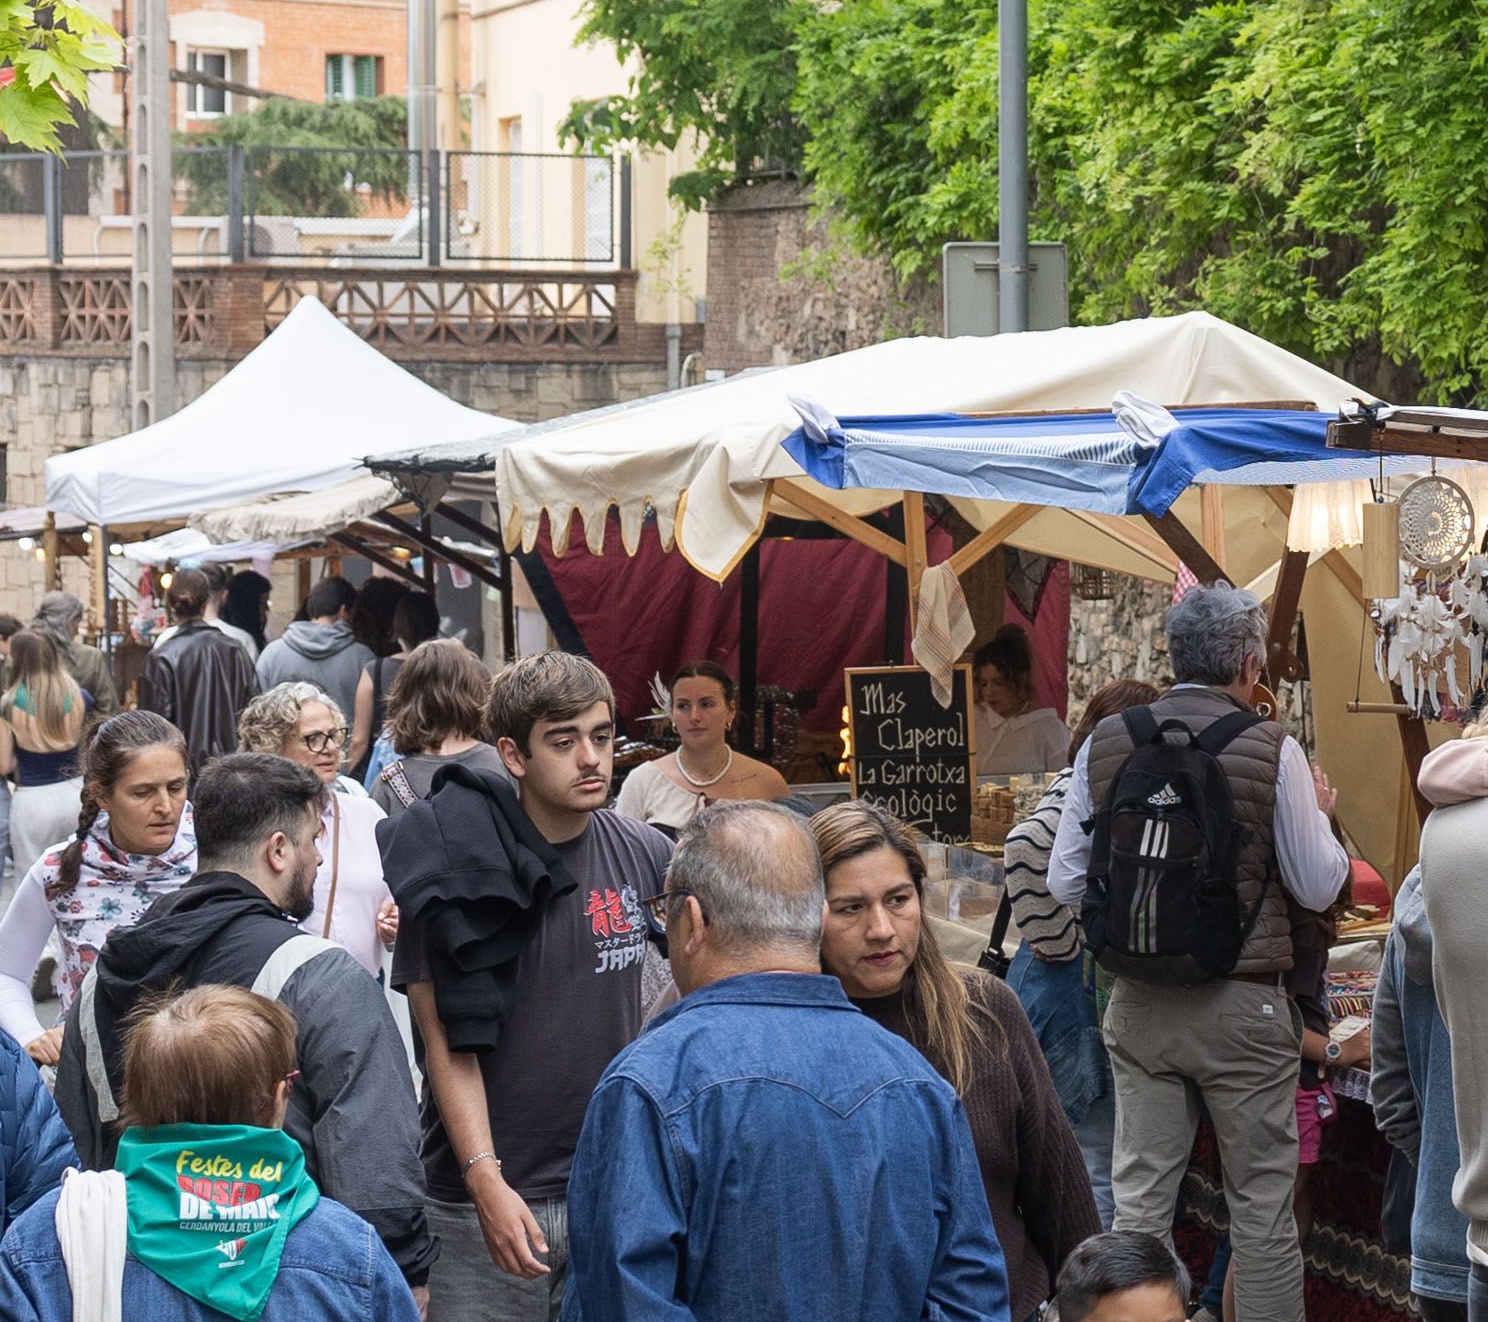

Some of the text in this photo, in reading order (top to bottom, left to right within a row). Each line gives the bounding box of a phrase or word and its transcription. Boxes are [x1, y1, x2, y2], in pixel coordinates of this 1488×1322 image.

[860, 682, 906, 715] Mas
[878, 712, 964, 763] Claperol
[858, 757, 965, 785] La Garrotxa
[176, 1150, 283, 1182] Festes del
[177, 1175, 261, 1207] ROSER
[180, 1192, 213, 1219] DE
[180, 1221, 235, 1233] CERDANYOLA
[236, 1222, 252, 1233] DEL
